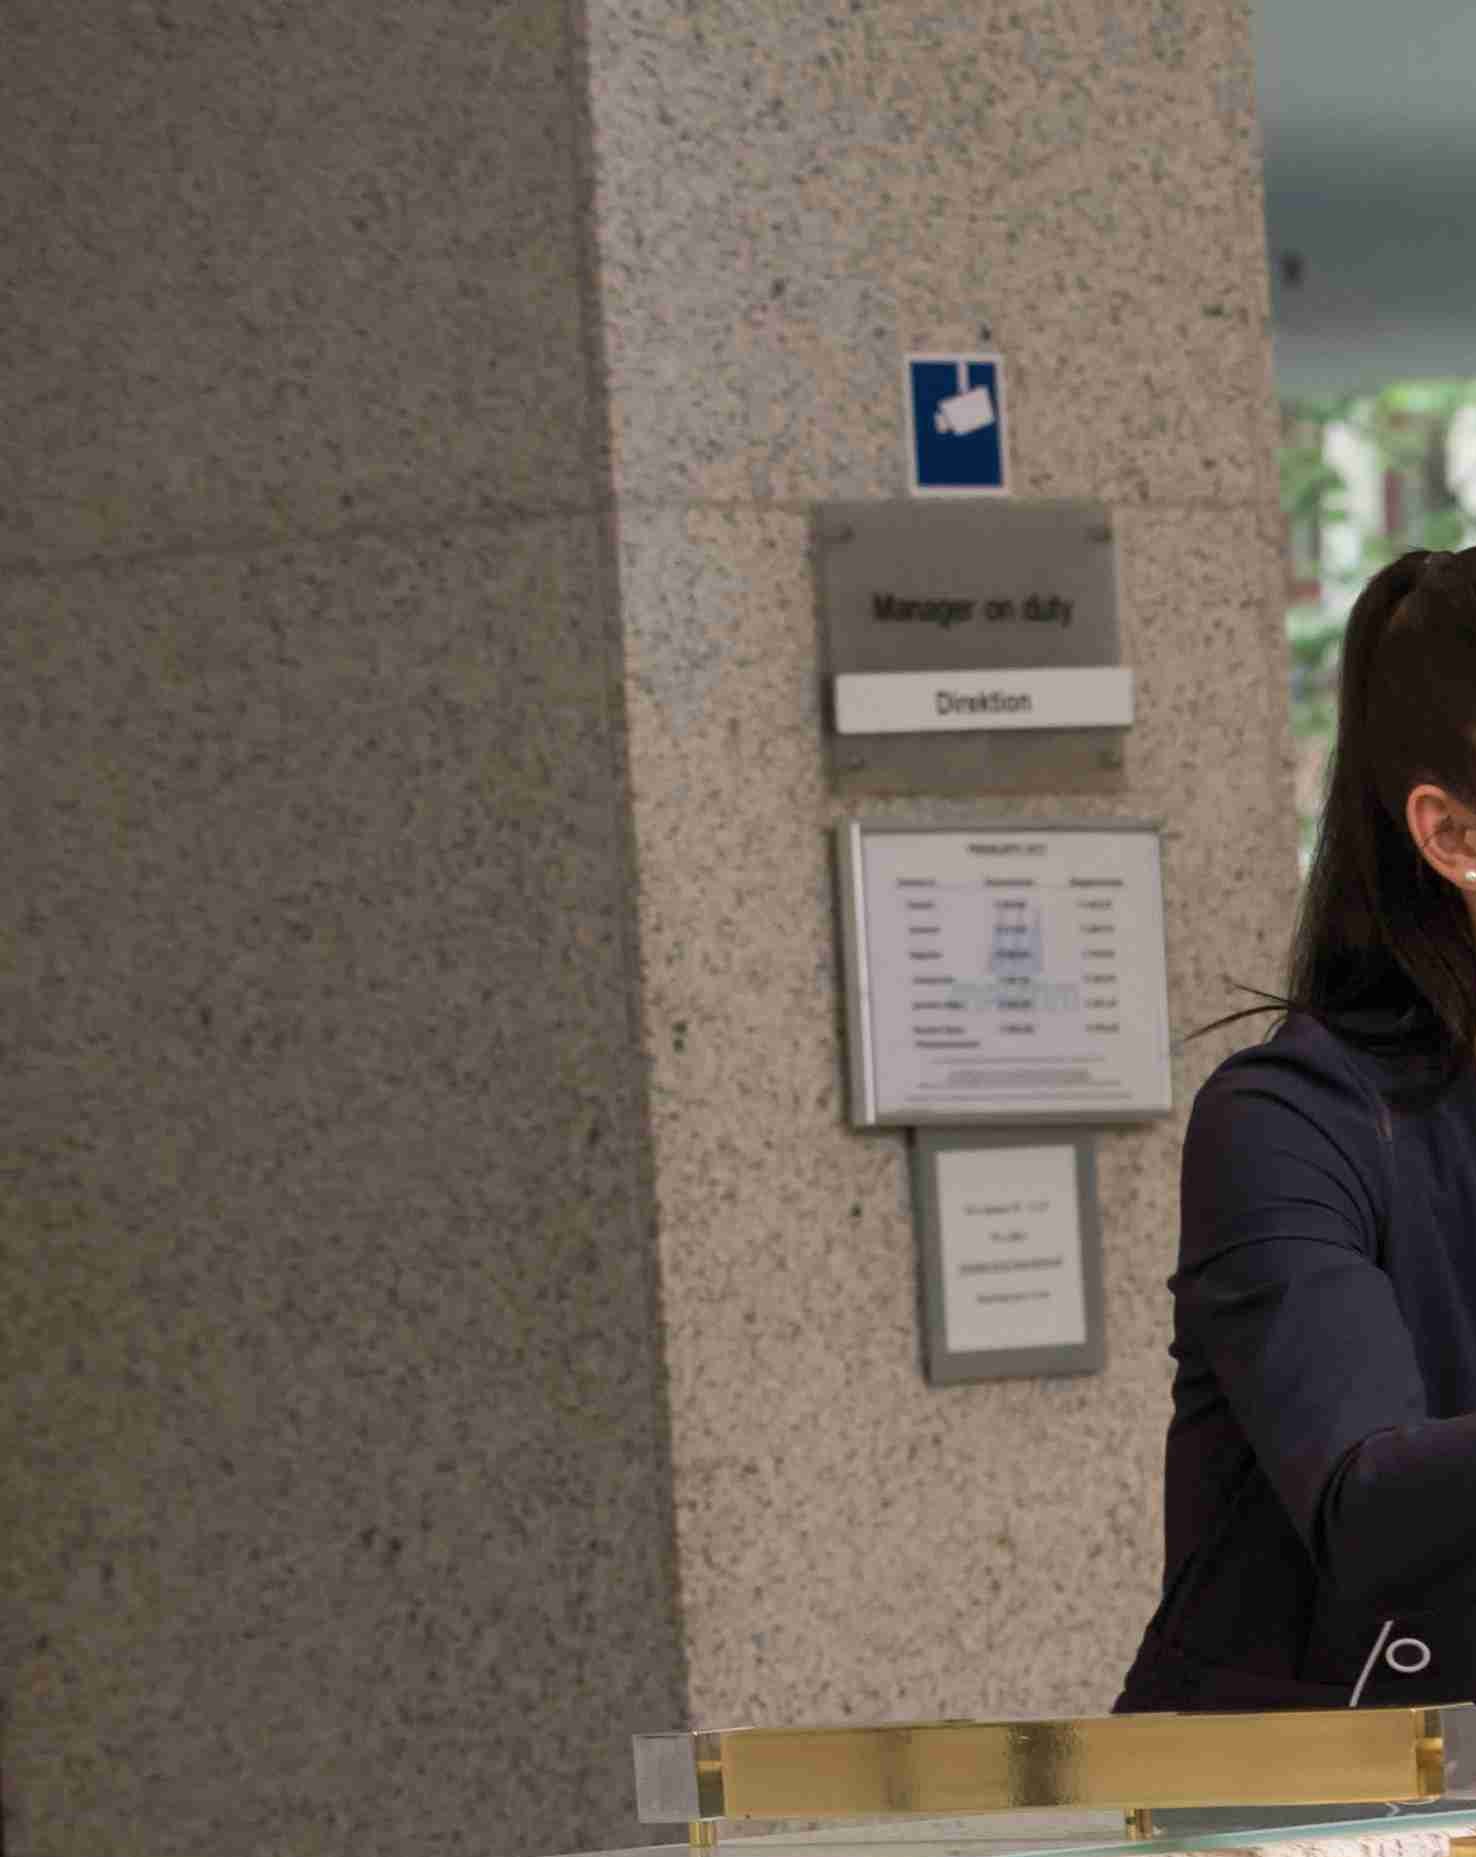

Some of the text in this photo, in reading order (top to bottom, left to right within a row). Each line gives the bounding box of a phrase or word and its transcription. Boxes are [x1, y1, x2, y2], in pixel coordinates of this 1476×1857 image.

[871, 593, 1073, 629] Manager on duty
[934, 691, 1033, 716] Direktion
